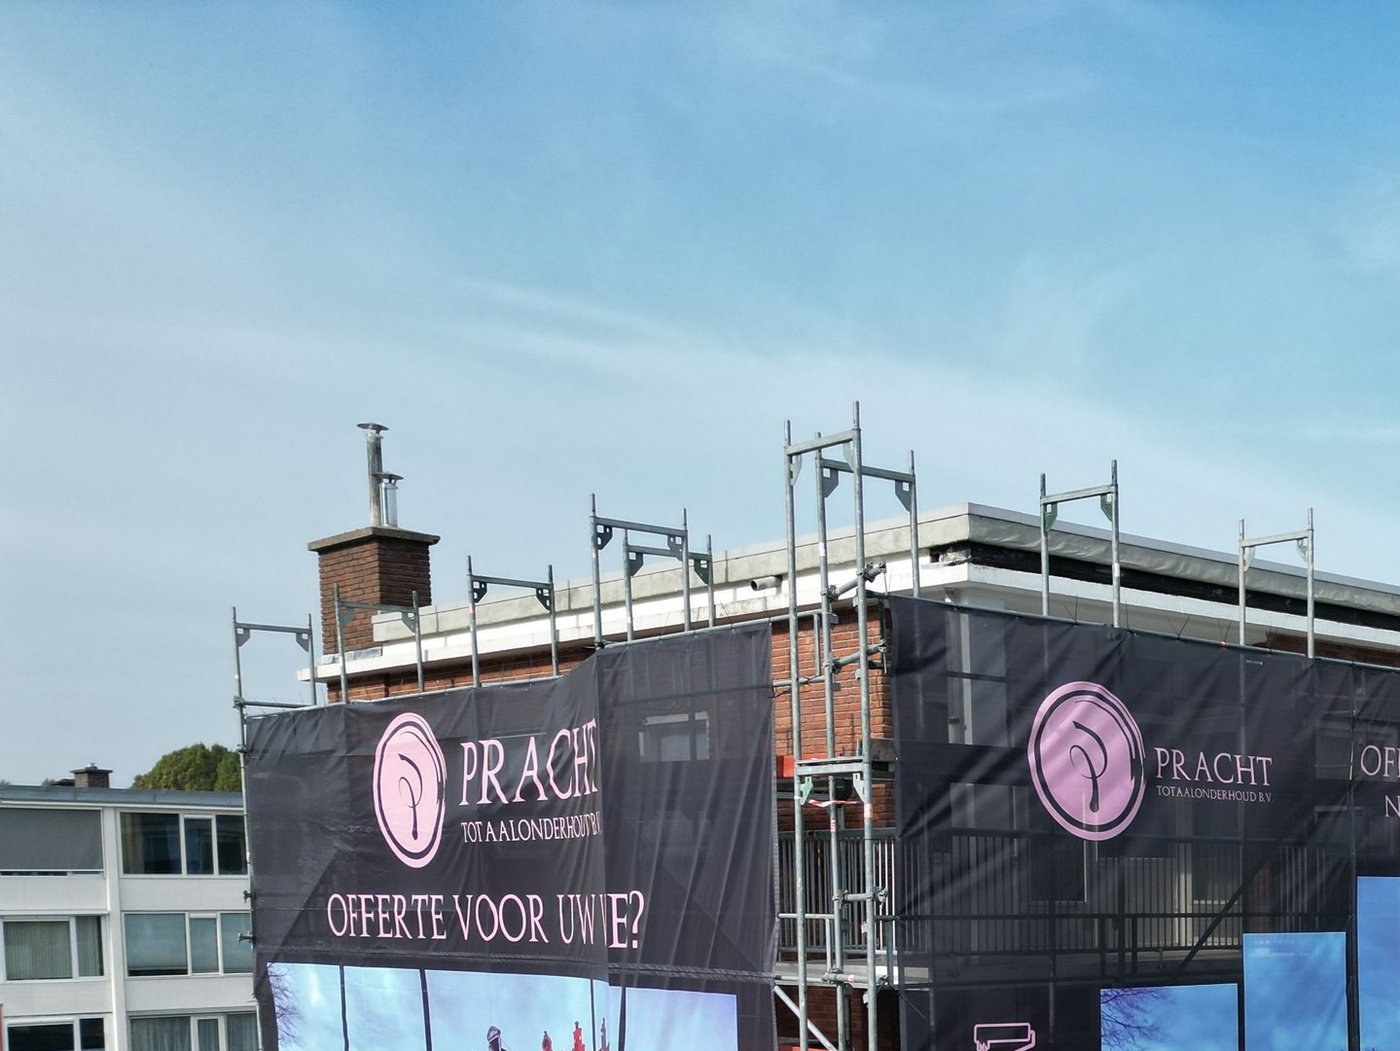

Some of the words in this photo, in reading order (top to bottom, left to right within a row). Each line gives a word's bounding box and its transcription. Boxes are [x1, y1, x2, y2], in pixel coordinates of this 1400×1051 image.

[458, 718, 599, 806] PRACHT
[1153, 747, 1273, 786] PRACHT
[1156, 785, 1257, 802] TOTAALONDERHOUD
[327, 893, 447, 940] OFFERTE
[453, 893, 549, 943] VOOR
[556, 893, 596, 945] UW
